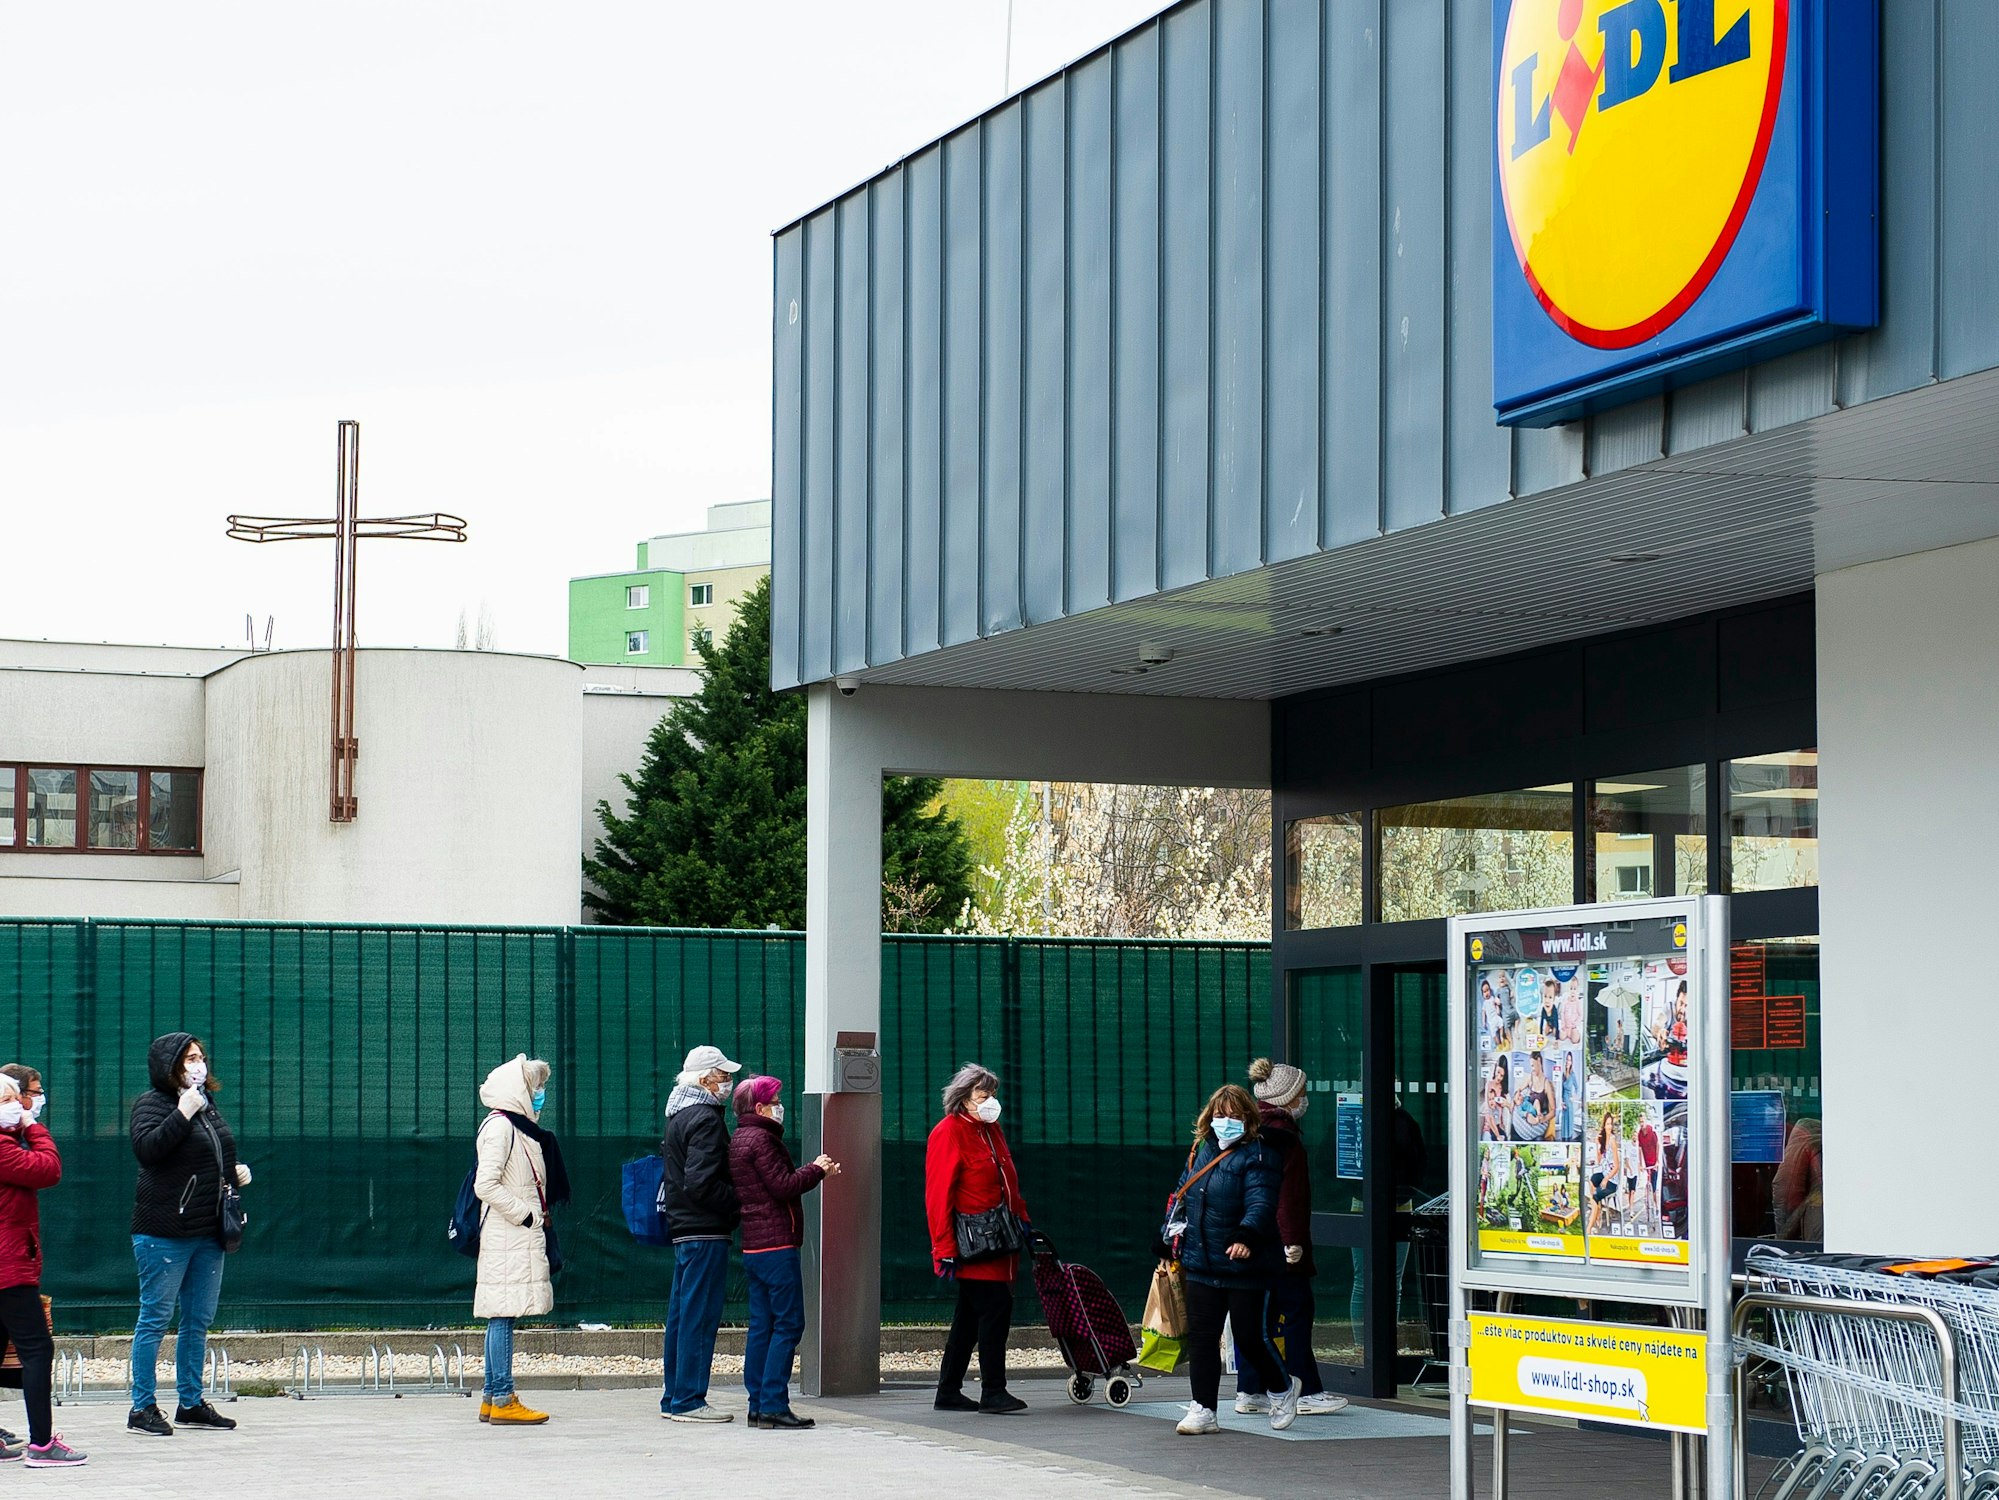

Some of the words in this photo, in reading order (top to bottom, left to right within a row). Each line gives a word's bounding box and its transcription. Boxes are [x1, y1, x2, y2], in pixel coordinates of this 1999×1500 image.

[1542, 931, 1607, 954] www.lidl.sk
[1504, 1324, 1522, 1340] viac
[1524, 1328, 1571, 1345] produktov
[1574, 1335, 1584, 1346] za
[1586, 1333, 1617, 1350] skvelé
[1619, 1340, 1642, 1356] ceny
[1644, 1339, 1682, 1359] nájdete
[1685, 1346, 1698, 1359] na
[1531, 1370, 1635, 1400] www.lidl-shop.sk
